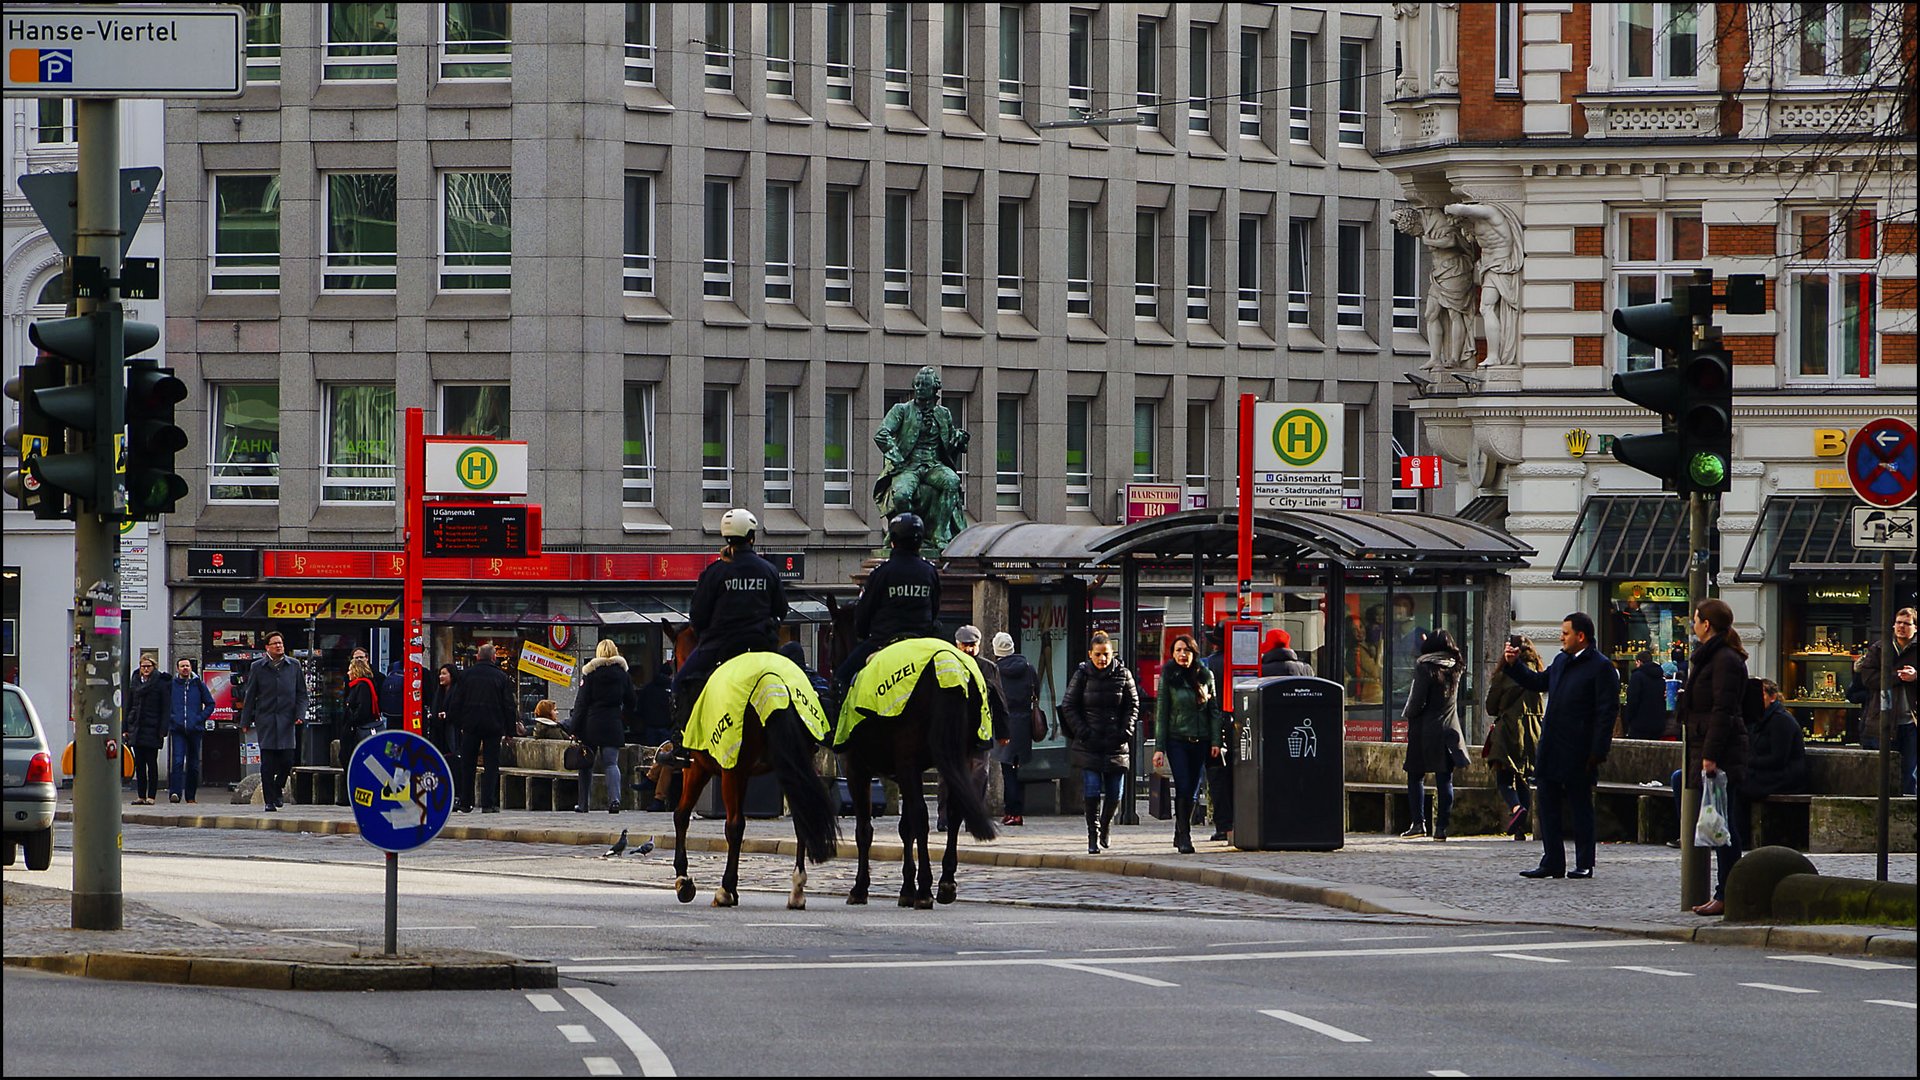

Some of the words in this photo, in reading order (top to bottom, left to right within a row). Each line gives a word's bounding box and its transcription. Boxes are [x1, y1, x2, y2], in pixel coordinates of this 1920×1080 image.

[8, 20, 177, 41] Hanse-Viertel
[47, 60, 64, 81] P
[231, 440, 272, 452] ZAHN
[346, 440, 385, 453] ARZT
[1276, 474, 1331, 482] Gänsemarkt
[1131, 490, 1178, 500] HAARSTUDIO
[1285, 487, 1341, 495] Stadtrundfahrt
[1280, 498, 1298, 507] City
[1144, 503, 1165, 516] IBO
[725, 579, 767, 591] POLIZEI
[889, 585, 931, 597] POLIZEI
[289, 603, 327, 614] LOTTO
[357, 604, 395, 615] LOTTO
